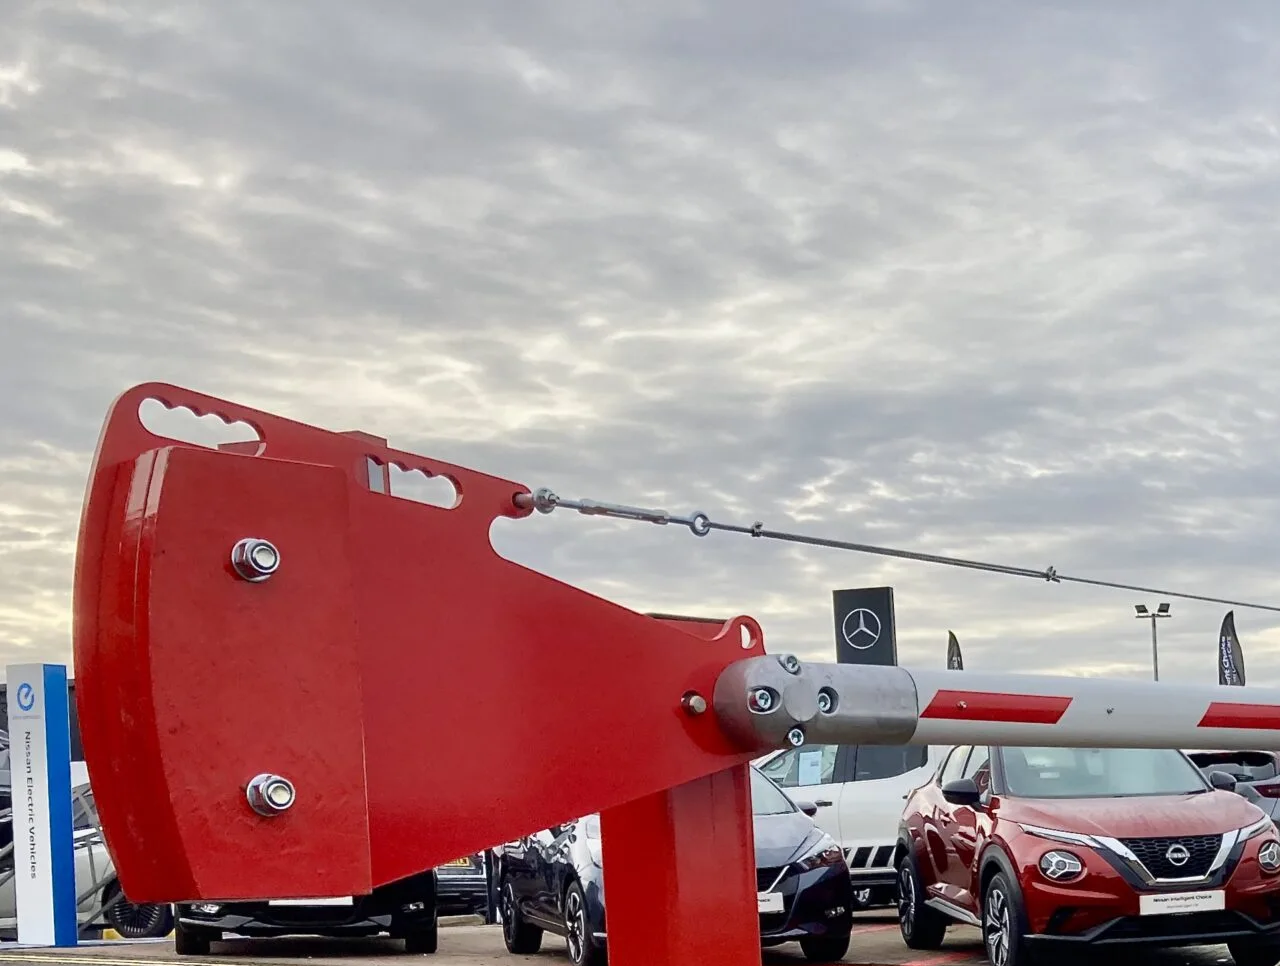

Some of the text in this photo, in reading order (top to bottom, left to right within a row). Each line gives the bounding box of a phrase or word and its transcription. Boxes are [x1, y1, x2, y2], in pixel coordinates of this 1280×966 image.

[1221, 635, 1230, 668] Choice
[24, 731, 37, 880] Nissan Electric Vehicles
